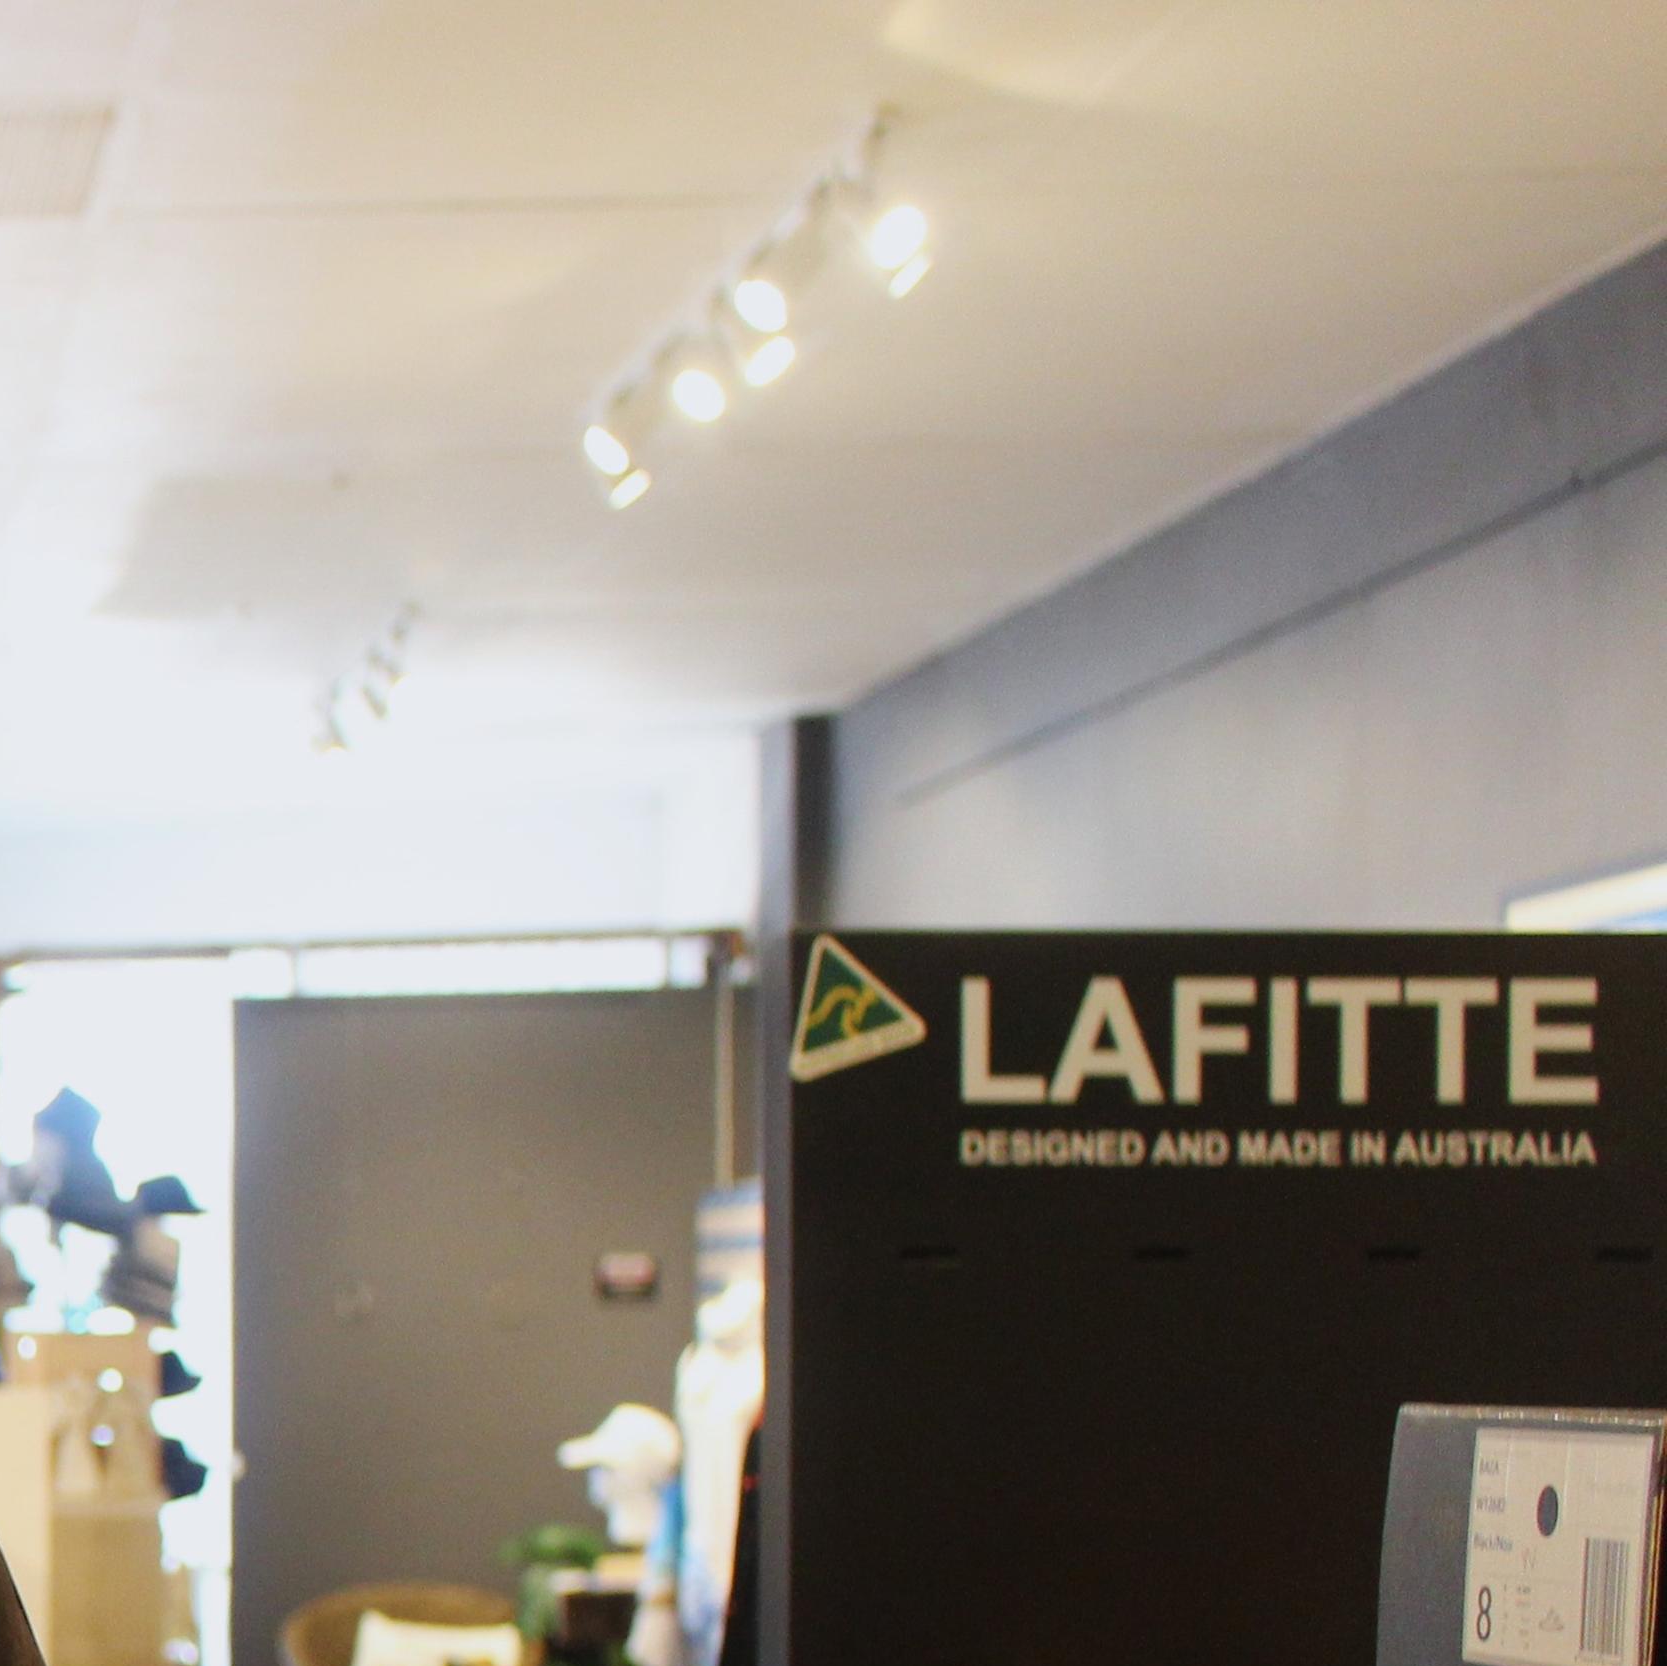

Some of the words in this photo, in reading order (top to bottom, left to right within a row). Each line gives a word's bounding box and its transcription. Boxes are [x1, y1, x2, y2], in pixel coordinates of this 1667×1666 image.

[960, 975, 1600, 1106] LAFITTE
[960, 1130, 1146, 1167] DESIGNED
[1152, 1130, 1231, 1167] AND
[1238, 1130, 1342, 1167] MADE
[1350, 1130, 1387, 1166] IN
[1393, 1130, 1598, 1167] AUSTRALIA
[1476, 1585, 1493, 1643] 8
